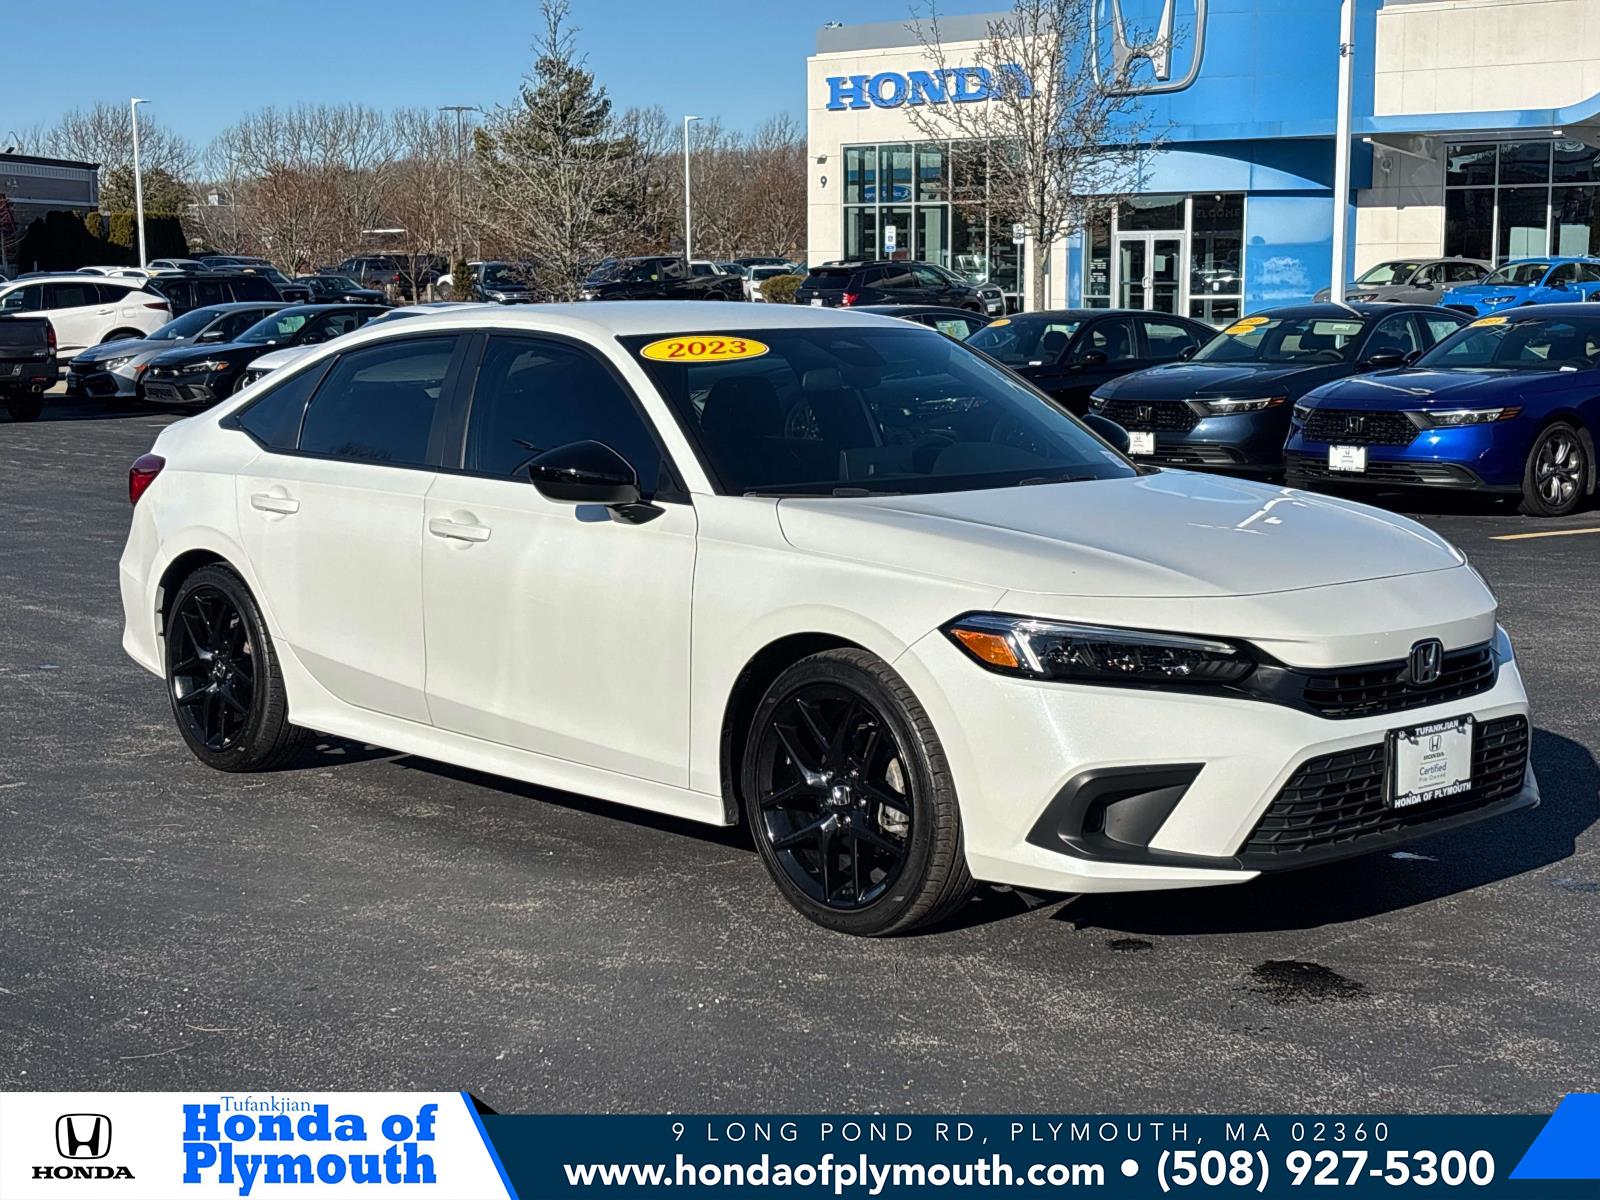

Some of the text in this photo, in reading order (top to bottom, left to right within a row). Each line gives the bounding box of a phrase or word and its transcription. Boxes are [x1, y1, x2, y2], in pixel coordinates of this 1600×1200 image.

[826, 63, 1039, 112] HONDA
[820, 175, 828, 189] 9
[667, 340, 747, 358] 2023
[1415, 719, 1459, 736] TUFANKJIAN
[1419, 761, 1447, 776] Certified
[1394, 781, 1472, 808] HONDA OF PLYMOUTH
